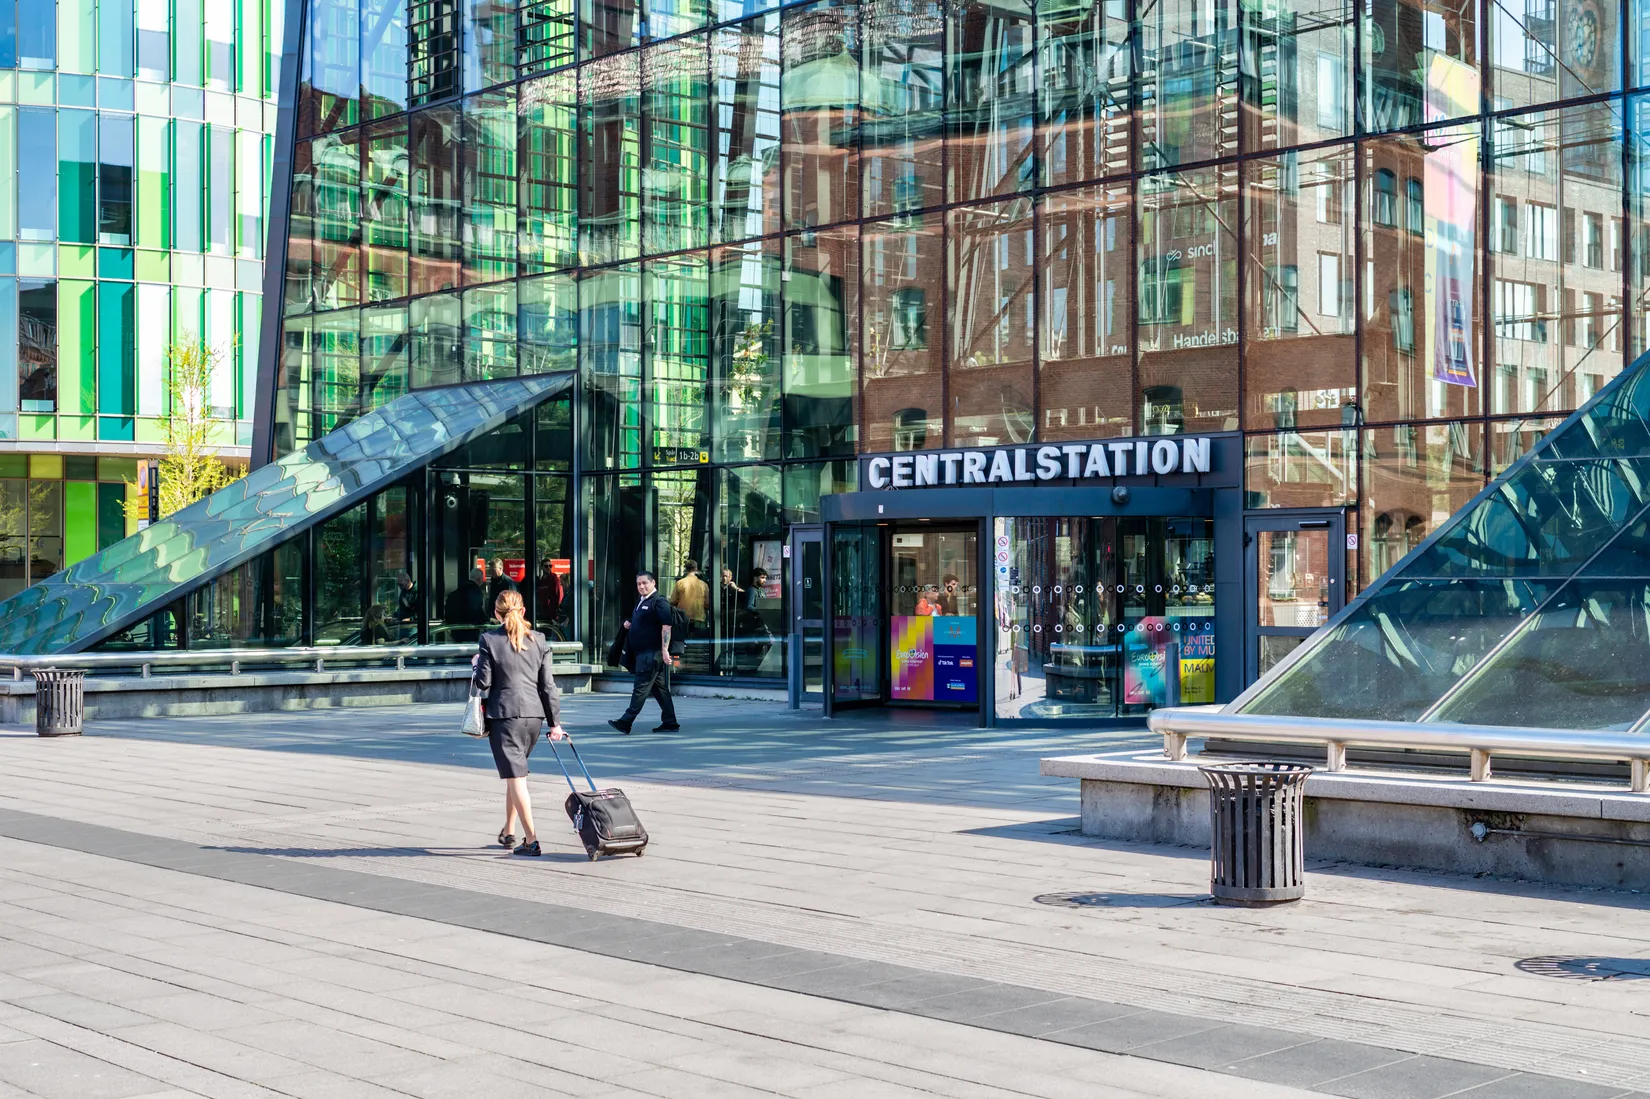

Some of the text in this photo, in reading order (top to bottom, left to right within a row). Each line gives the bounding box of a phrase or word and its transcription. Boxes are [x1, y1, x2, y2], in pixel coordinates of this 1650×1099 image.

[679, 451, 699, 460] 1b-2b
[868, 438, 1211, 489] CENTRALSTATION
[1184, 645, 1215, 655] BY MU
[1184, 663, 1215, 673] MALM
